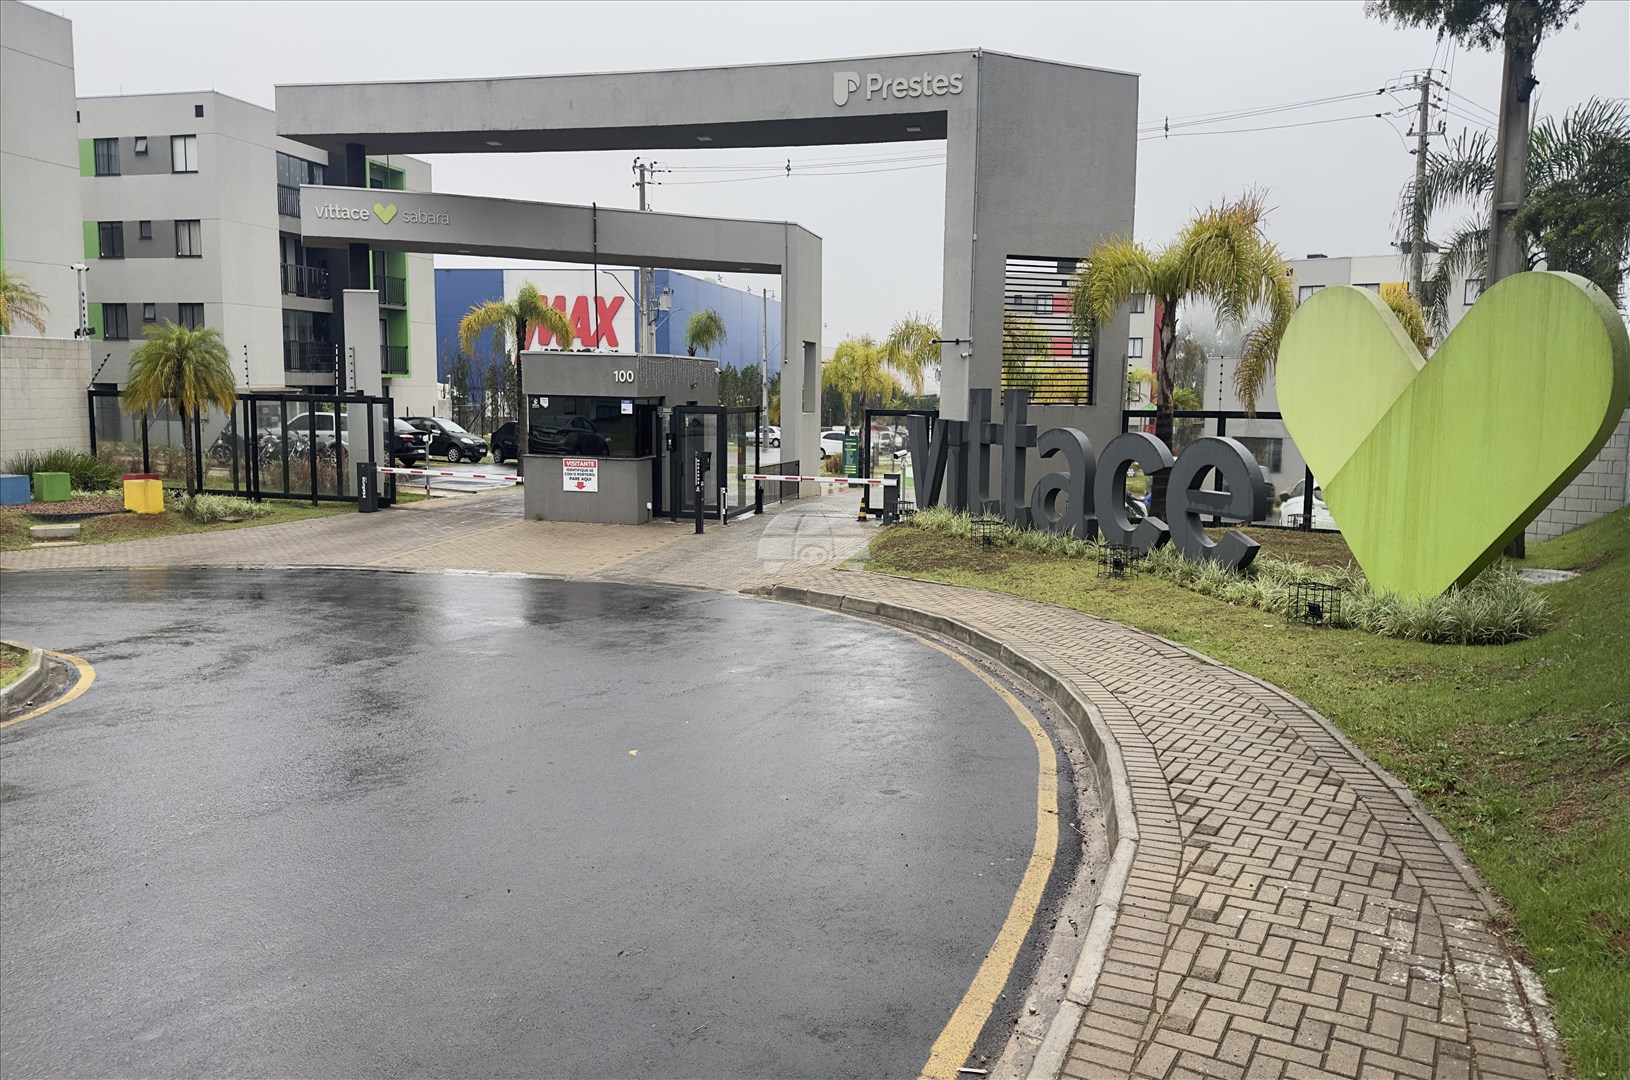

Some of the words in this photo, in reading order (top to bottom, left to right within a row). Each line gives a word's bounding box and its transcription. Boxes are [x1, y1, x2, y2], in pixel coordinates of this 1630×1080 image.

[866, 71, 964, 101] Prestes
[314, 203, 370, 221] vittace
[402, 209, 450, 225] sabará
[523, 295, 625, 349] MAX
[613, 370, 634, 383] 100
[906, 388, 1267, 571] vittace
